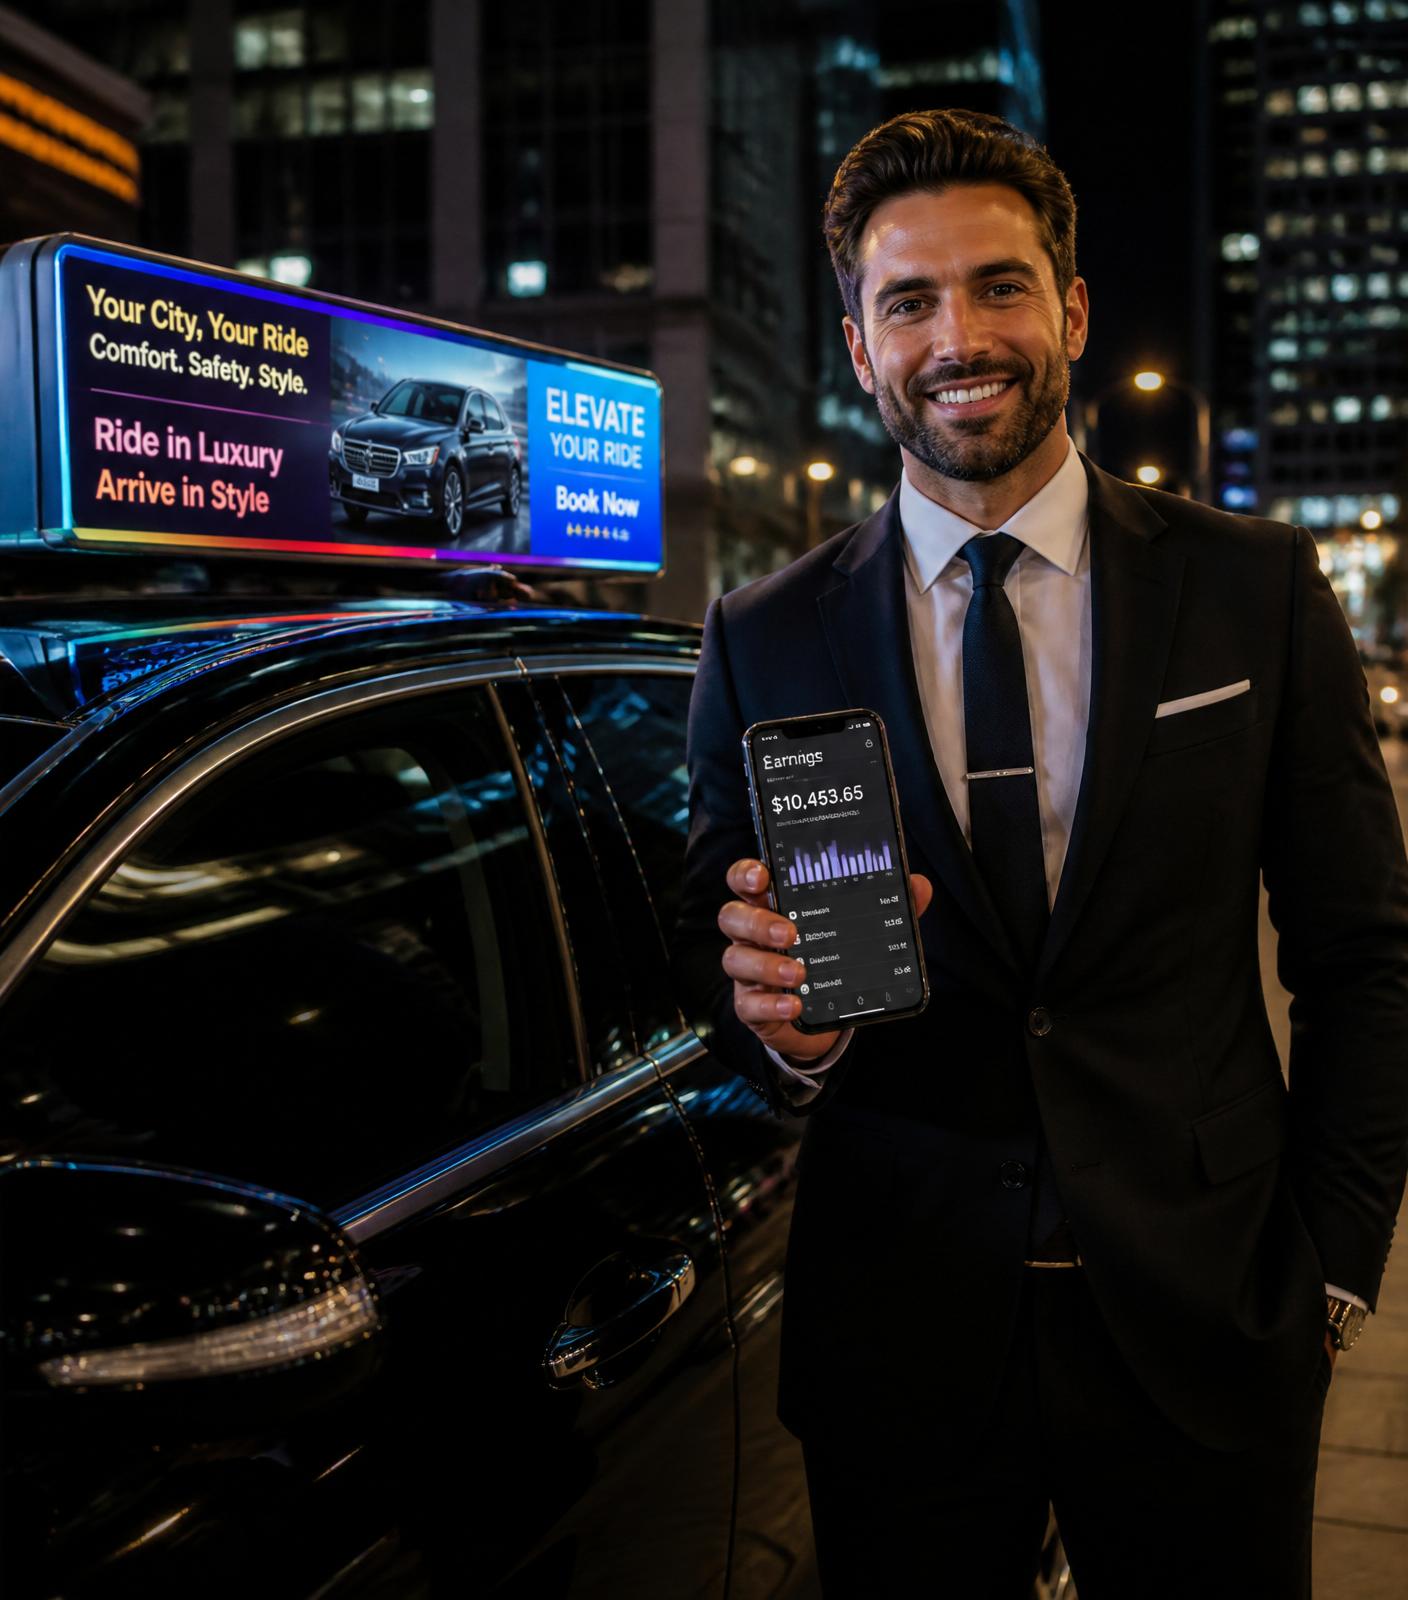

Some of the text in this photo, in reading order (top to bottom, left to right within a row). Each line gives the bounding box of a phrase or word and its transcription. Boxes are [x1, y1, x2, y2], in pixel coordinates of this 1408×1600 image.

[86, 284, 309, 357] Your City, Your Ride
[89, 333, 308, 396] Comfort. Safety. Style.
[546, 387, 646, 438] ELEVATE
[94, 417, 283, 478] Ride in Luxury
[550, 431, 643, 470] YOUR RIDE
[95, 468, 270, 518] Arrive in Style
[555, 485, 640, 519] Book Now
[771, 785, 864, 815] $10,453.65
